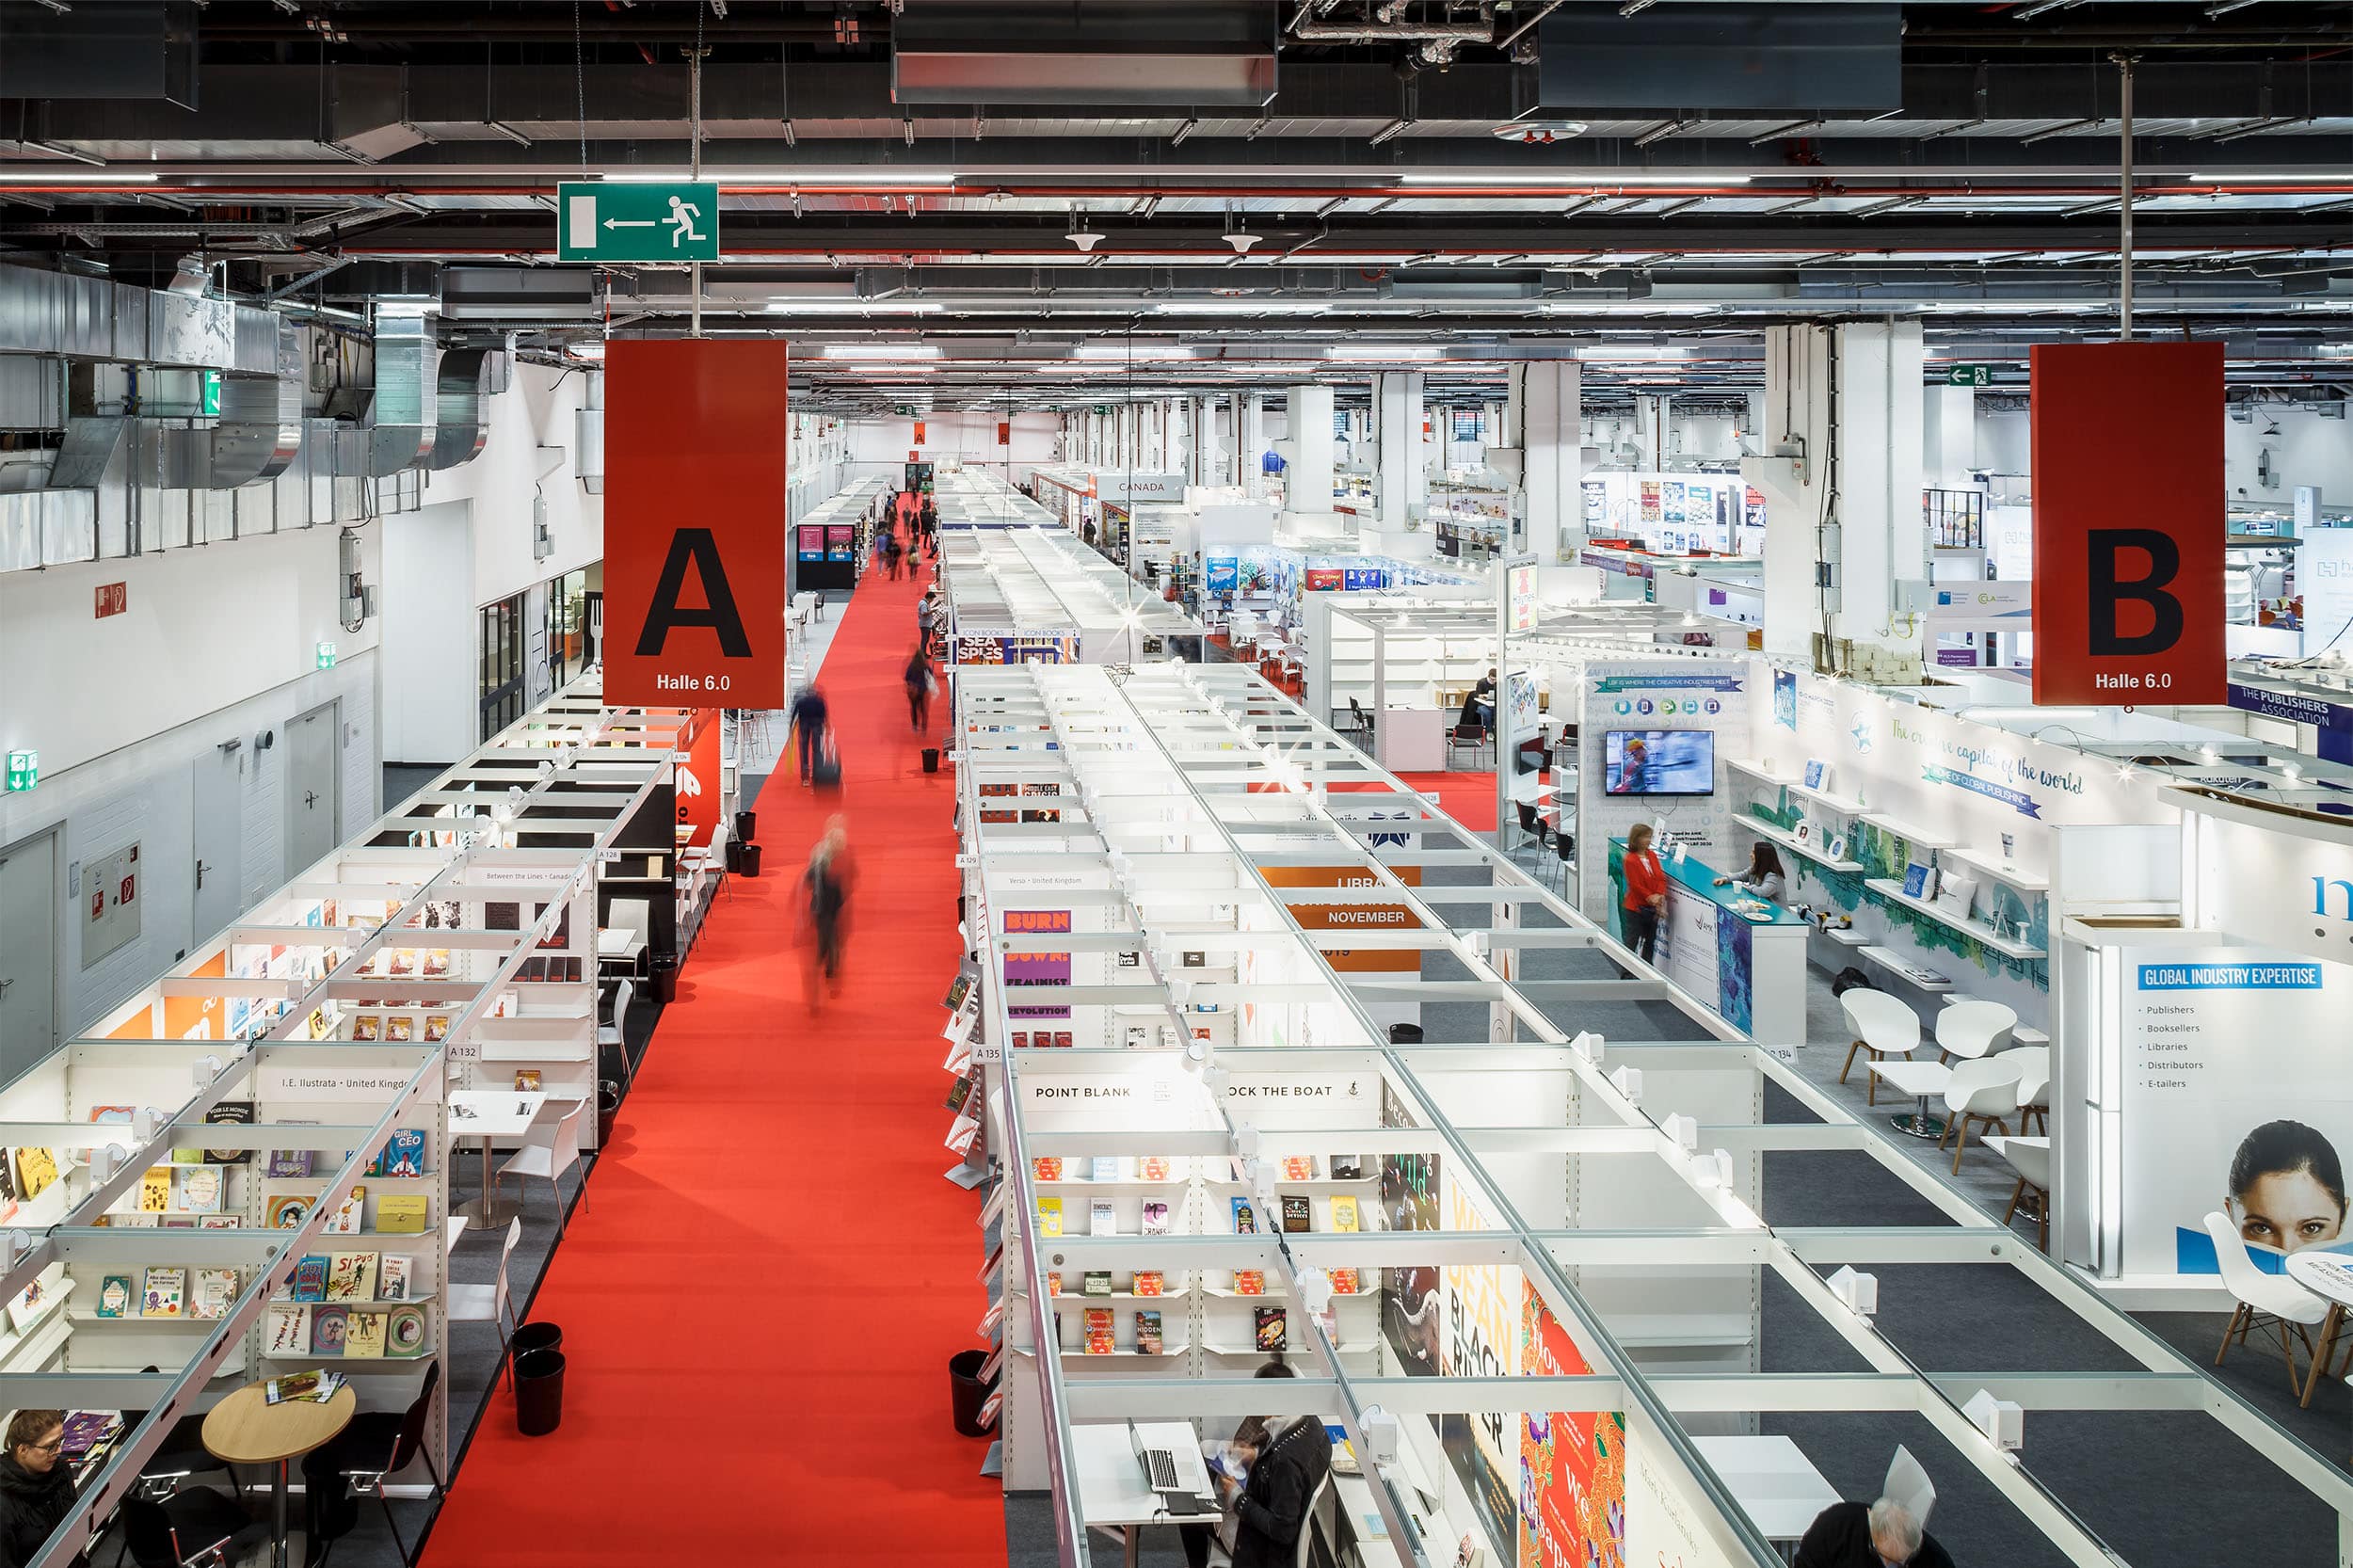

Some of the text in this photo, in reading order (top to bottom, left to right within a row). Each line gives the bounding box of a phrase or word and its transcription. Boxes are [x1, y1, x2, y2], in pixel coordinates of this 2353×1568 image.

[1119, 483, 1164, 491] CANADA
[634, 528, 753, 657] A
[2089, 529, 2184, 656] B
[657, 674, 730, 691] Halle 6.0
[2096, 674, 2171, 689] Halle 6.0
[2241, 687, 2329, 713] THE PUBLISHERS
[2261, 704, 2329, 727] ASSOCIATION
[1892, 719, 1907, 740] The
[2018, 757, 2036, 779] the
[2041, 770, 2084, 794] world
[1006, 913, 1068, 930] BURN
[1329, 912, 1404, 922] NOVEMBER
[2145, 968, 2316, 984] GLOBAL INDUSTRY EXPERTISE
[2147, 1006, 2195, 1015] Publishers
[2147, 1024, 2201, 1032] Booksellers
[450, 1048, 476, 1056] A 132
[986, 1049, 1000, 1058] 135
[346, 1080, 376, 1088] United
[378, 1080, 408, 1090] Kingdo
[2148, 1080, 2185, 1088] E-tailers
[1036, 1088, 1129, 1097] POINT BLANK
[1227, 1086, 1333, 1096] OCK THE BOAT
[394, 1129, 412, 1138] GIRL
[399, 1136, 421, 1146] CEO
[1565, 1462, 1589, 1521] We
